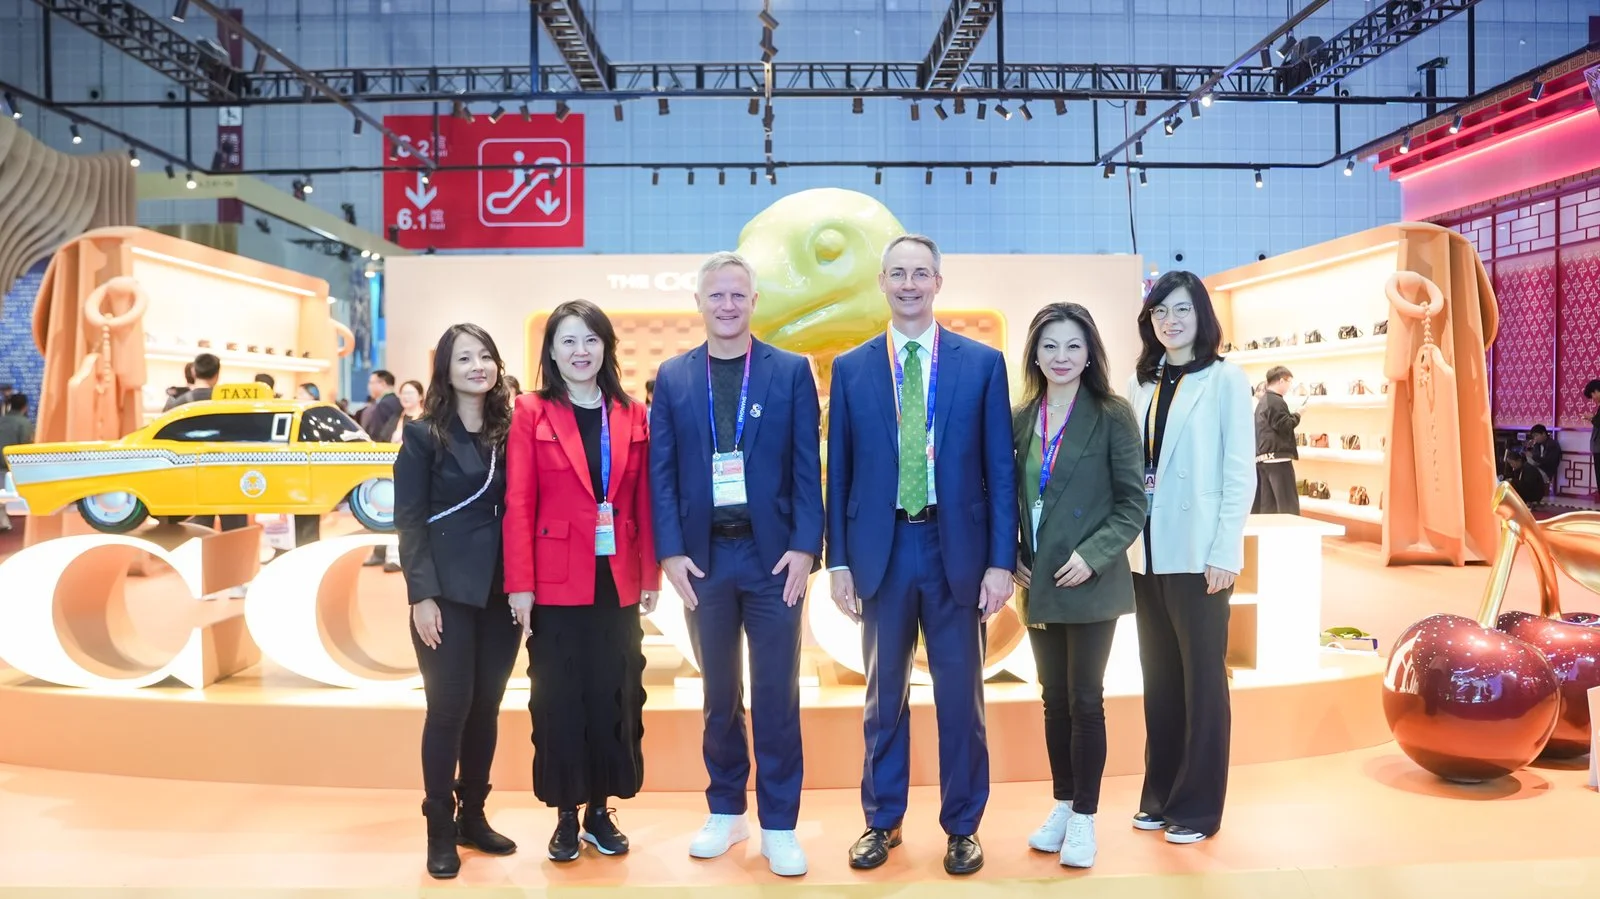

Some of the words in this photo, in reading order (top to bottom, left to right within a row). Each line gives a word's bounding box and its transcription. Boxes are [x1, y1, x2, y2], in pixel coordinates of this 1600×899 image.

[397, 208, 427, 230] 6.1
[607, 274, 650, 289] THE
[221, 388, 259, 399] TAXI
[738, 396, 747, 423] SHANGHAI
